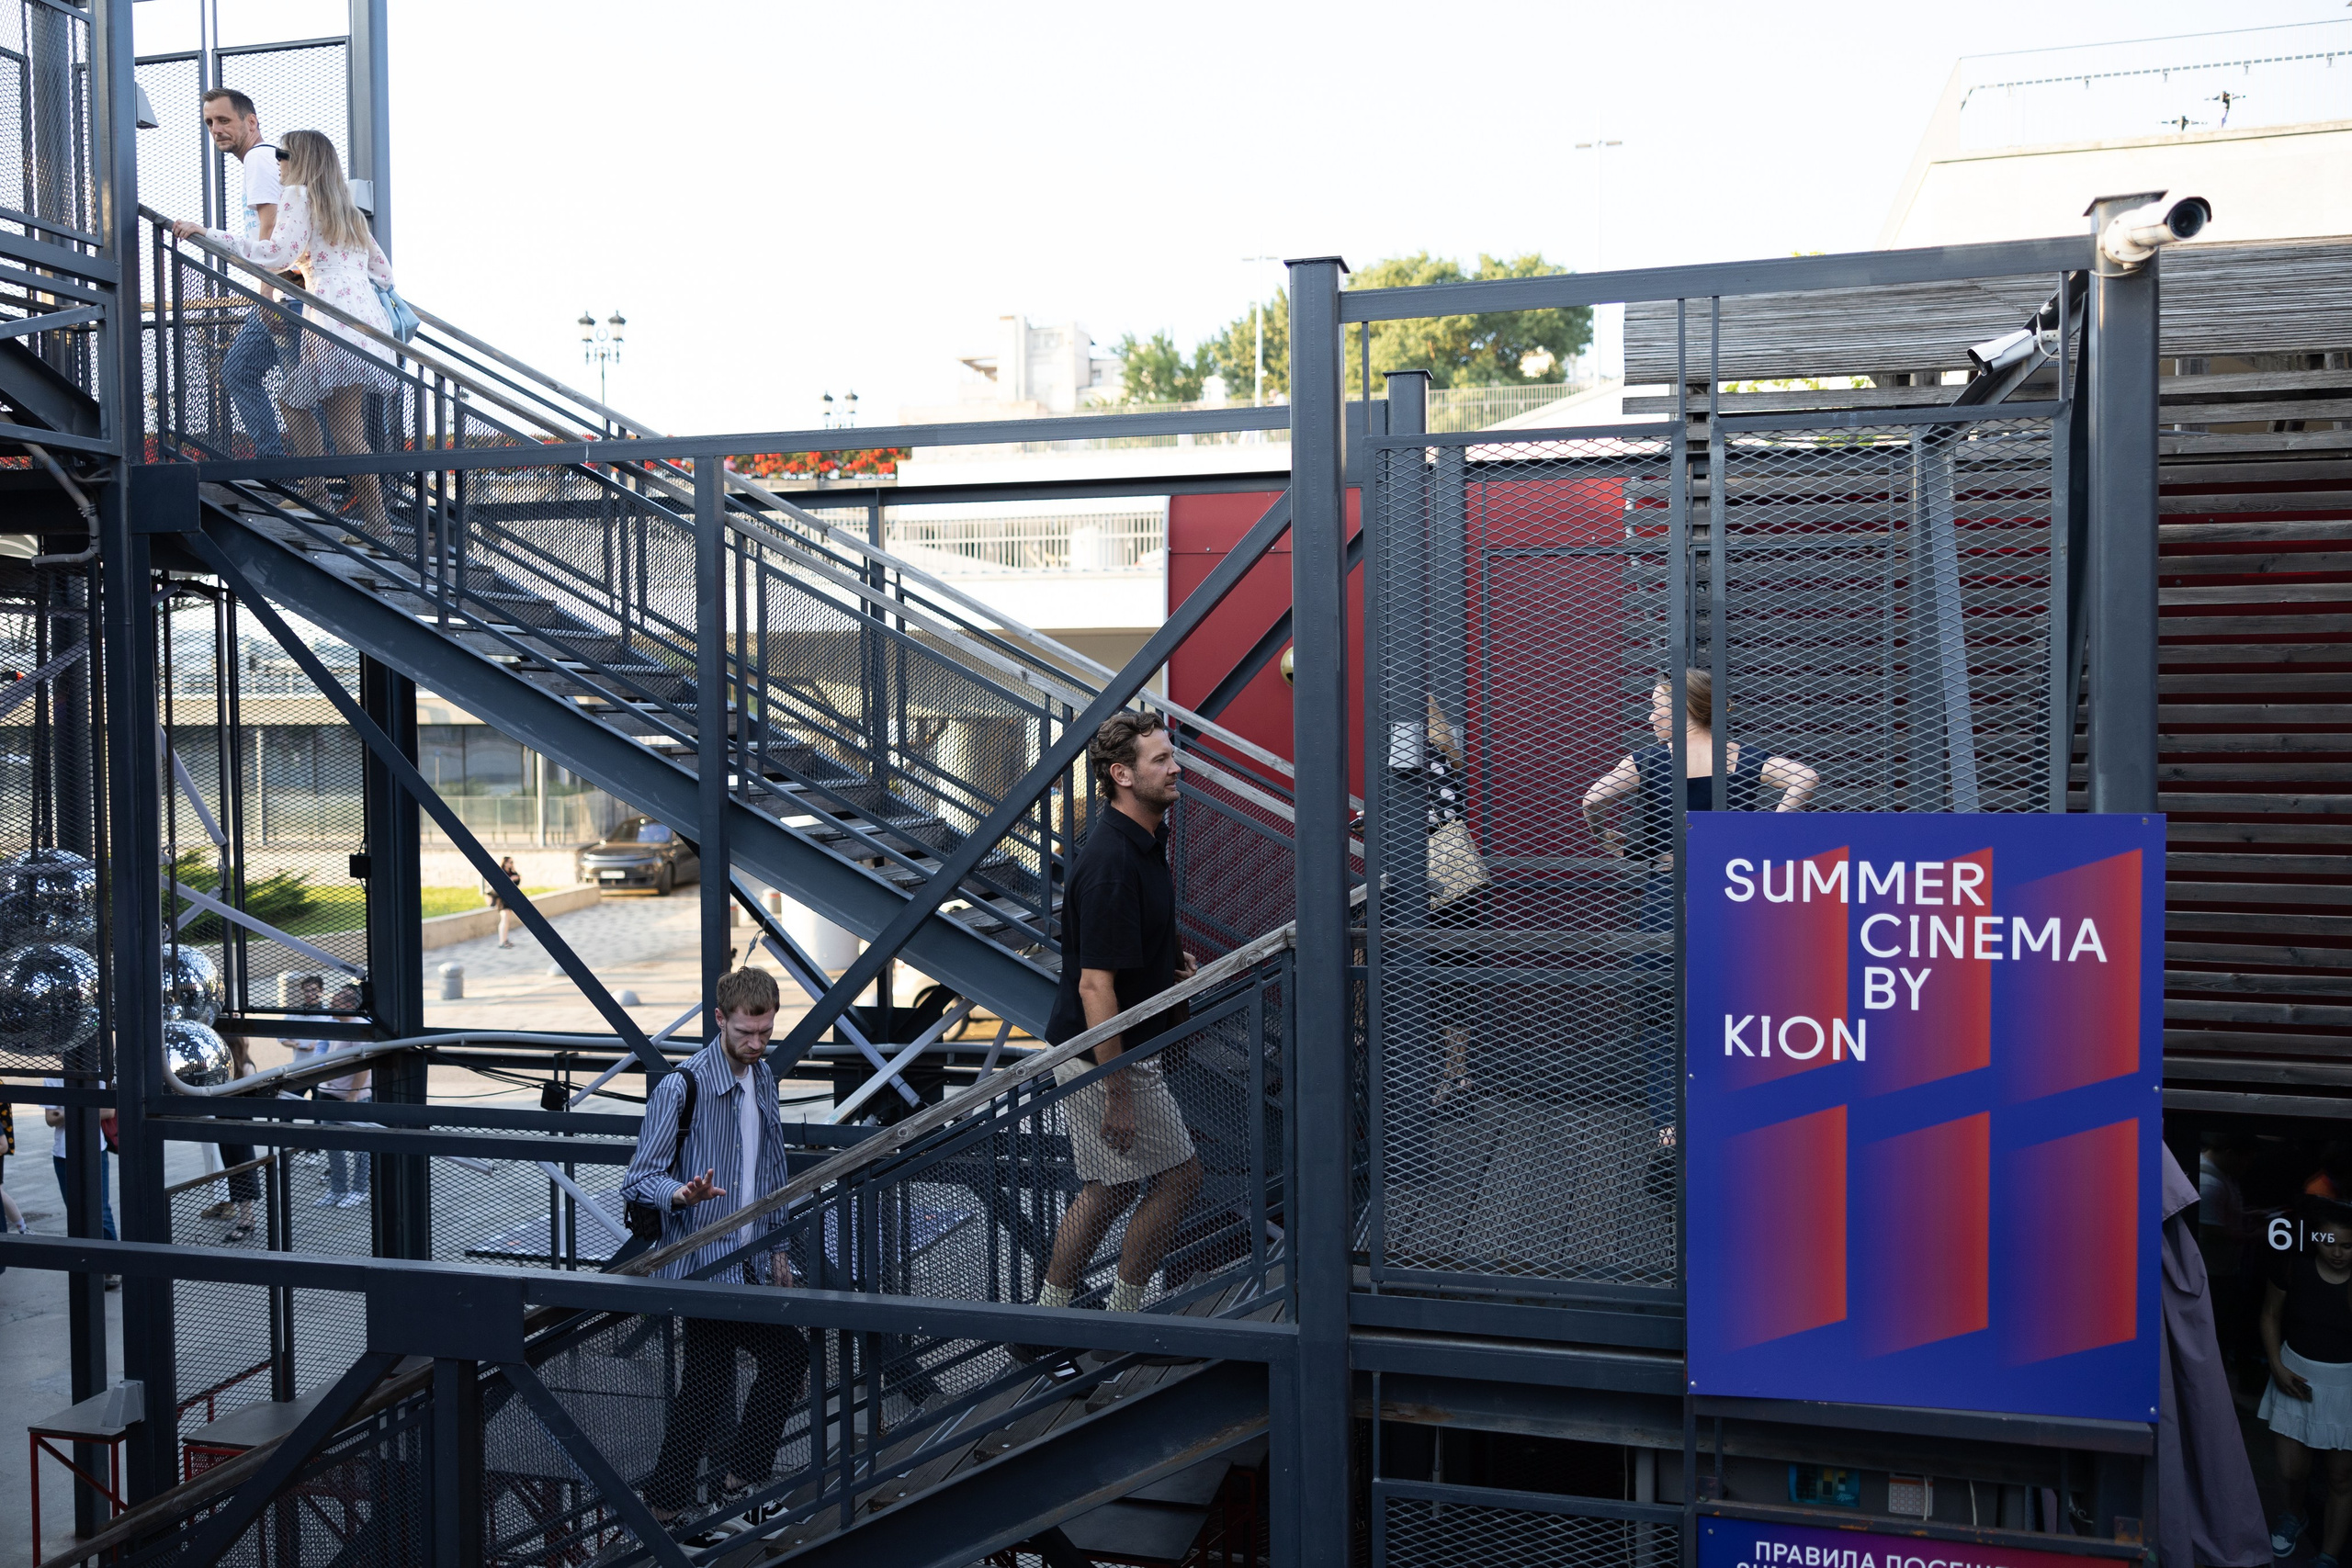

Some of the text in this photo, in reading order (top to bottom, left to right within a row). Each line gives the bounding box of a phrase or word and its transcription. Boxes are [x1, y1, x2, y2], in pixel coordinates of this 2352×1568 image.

[1724, 858, 1985, 907] SUMMER
[1860, 912, 2108, 963] CINEMA
[1864, 966, 1932, 1011] BY
[1724, 1014, 1866, 1062] KION
[2267, 1217, 2335, 1250] 6 КУБ
[1756, 1540, 1877, 1568] ПРАВИЛА
